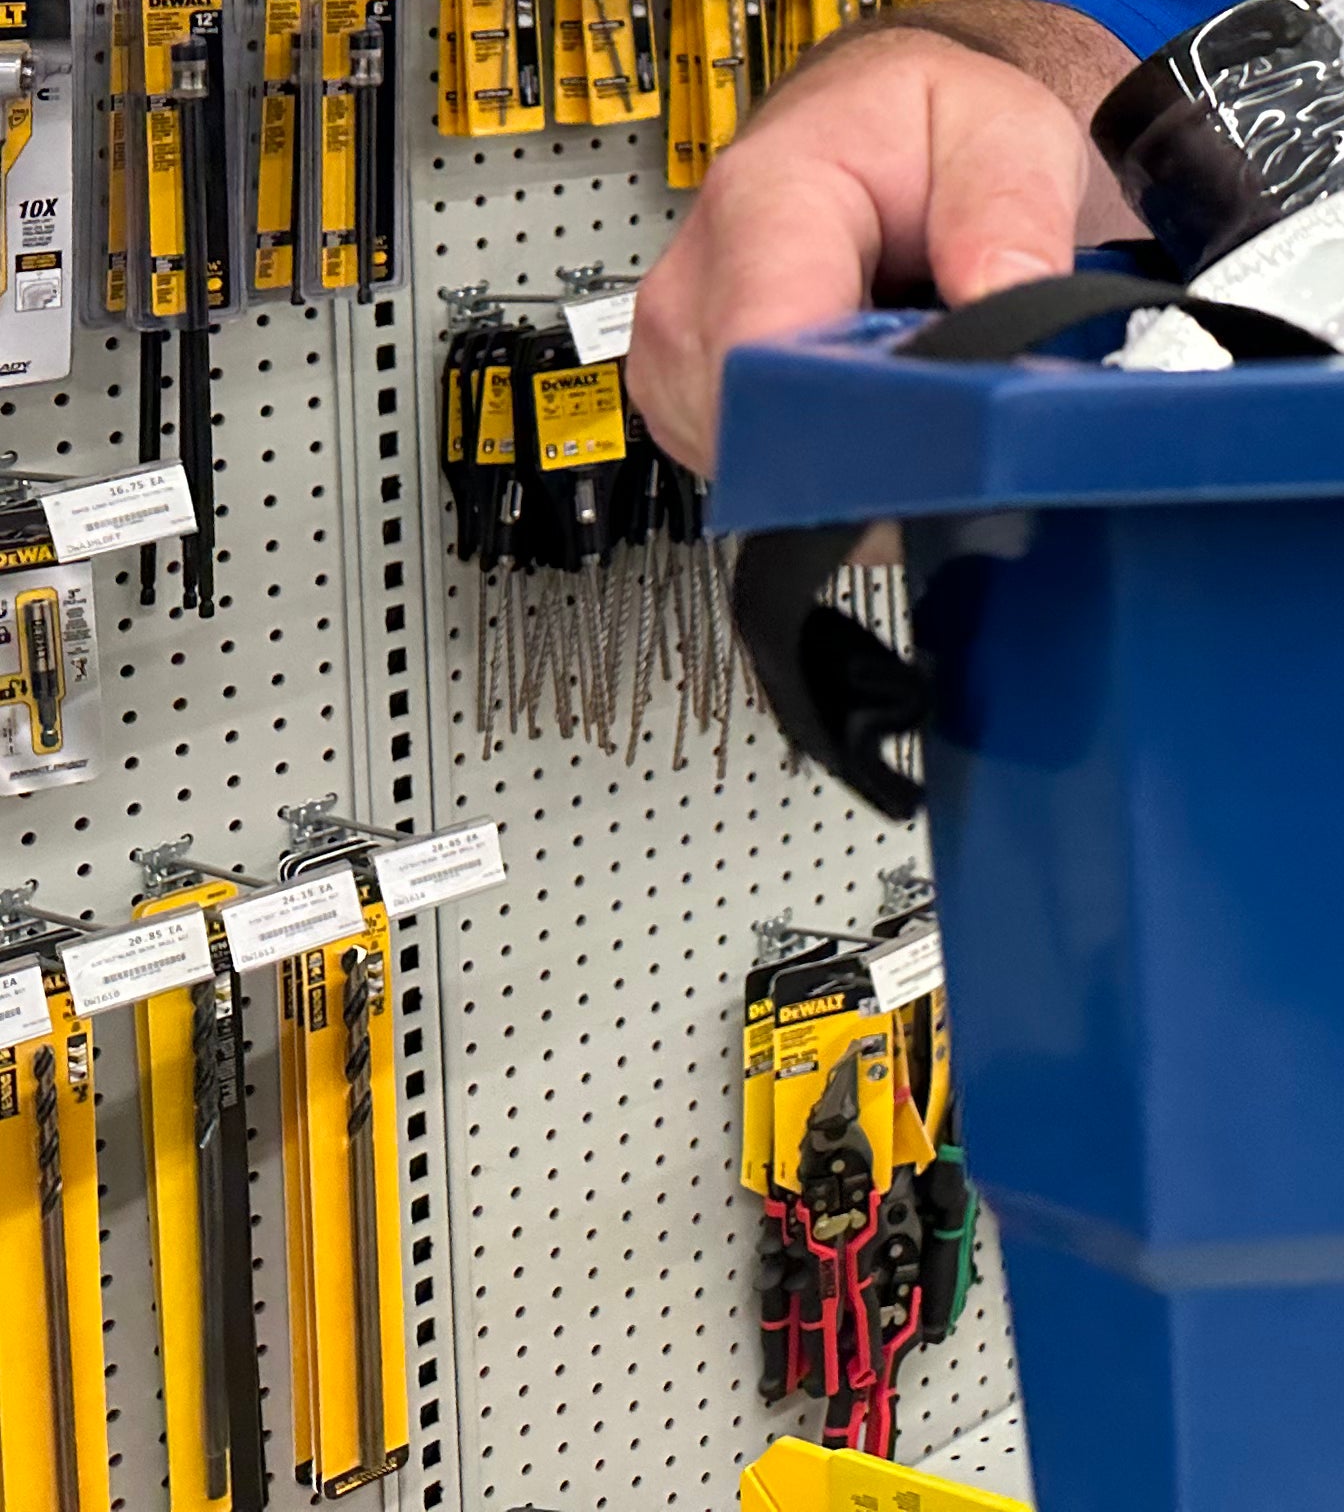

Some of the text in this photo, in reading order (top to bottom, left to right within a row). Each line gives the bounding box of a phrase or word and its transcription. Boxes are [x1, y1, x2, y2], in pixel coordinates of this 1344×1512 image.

[19, 198, 59, 219] 10X
[541, 373, 599, 393] DEWALT
[109, 479, 145, 497] 16.75
[129, 930, 163, 947] 20.85
[780, 993, 846, 1024] DEWALT
